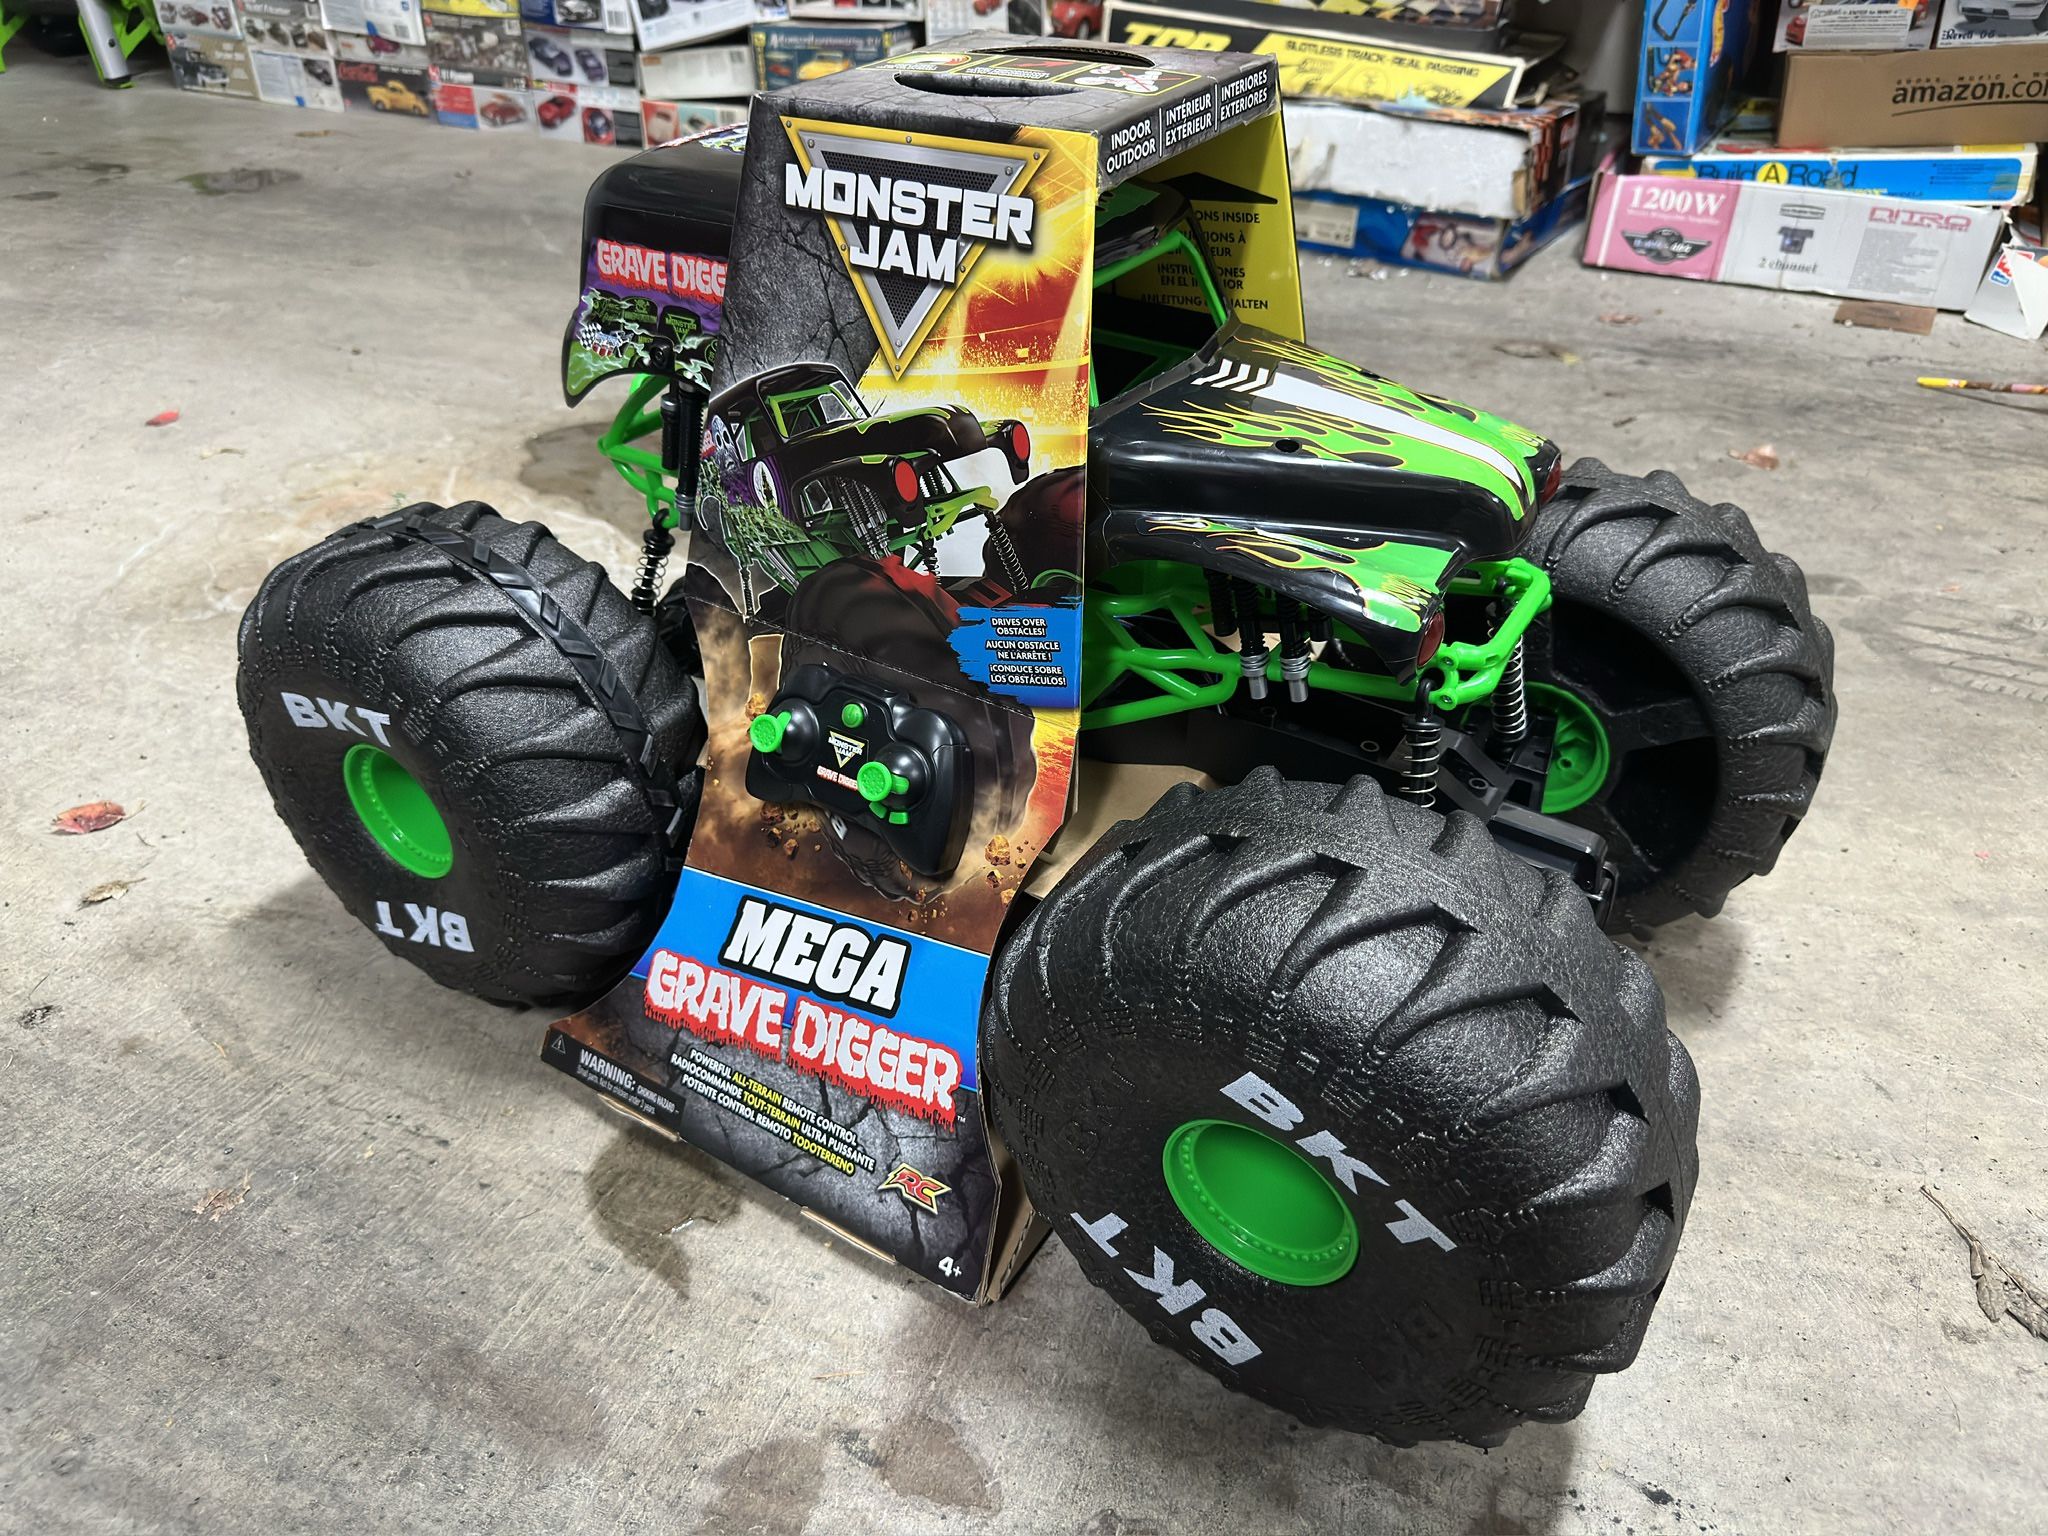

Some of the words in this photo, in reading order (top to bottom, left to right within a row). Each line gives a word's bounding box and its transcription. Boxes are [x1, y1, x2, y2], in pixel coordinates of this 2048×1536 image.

[1346, 49, 1385, 62] TRACK
[1221, 69, 1268, 101] INTERIORES
[1165, 93, 1212, 126] INTÉRIEUR
[1220, 87, 1268, 121] EXTERIORES
[1111, 119, 1151, 150] INDOOR
[1165, 112, 1212, 146] EXTÉRIEUR
[1106, 138, 1156, 173] OUTDOOR
[1763, 164, 1781, 184] A
[785, 163, 1034, 245] MONSTER
[1223, 212, 1260, 223] INSIDE
[1631, 186, 1726, 217] 1200W
[1238, 230, 1247, 243] À
[597, 239, 668, 287] GRAVE
[850, 225, 957, 283] JAM
[991, 618, 1021, 627] DRIVES
[1022, 618, 1046, 627] OVER
[996, 627, 1046, 636] OBSTACLES!
[986, 640, 1015, 649] AUCUN
[1017, 641, 1060, 650] OBSTACLE
[998, 651, 1009, 659] NE
[989, 664, 1033, 673] ¡CONDUCE
[1034, 665, 1062, 674] SOBRE
[991, 674, 1007, 683] LOS
[1008, 674, 1067, 686] OBSTÁCULOS!
[281, 692, 391, 747] BKT
[828, 736, 863, 756] MONSTER
[837, 747, 853, 758] JAM
[375, 900, 475, 952] BKT
[723, 899, 908, 1011] MEGA
[648, 950, 786, 1050] GRAVE
[792, 999, 959, 1110] DIGGER
[580, 1049, 637, 1092] WARNING:
[656, 1095, 675, 1114] HAZARD
[690, 1049, 732, 1079] POWERFUL
[732, 1071, 783, 1103] ALL-TERRAIN
[782, 1098, 816, 1125] REMOTE
[816, 1115, 858, 1146] CONTROL
[670, 1053, 743, 1099] RADIOCOMMANDE
[742, 1092, 801, 1131] TOUT-TERRAIN
[800, 1122, 827, 1147] ULTRA
[827, 1138, 876, 1172] PUISSANTE
[681, 1073, 717, 1100] POTENTE
[716, 1092, 756, 1121] CONTROL
[755, 1113, 792, 1141] REMOTO
[791, 1132, 855, 1175] TODOTERRENO
[1219, 1070, 1458, 1252] BKT
[890, 1168, 943, 1207] RC
[938, 1256, 962, 1277] 4+
[1069, 1211, 1263, 1366] BKT
